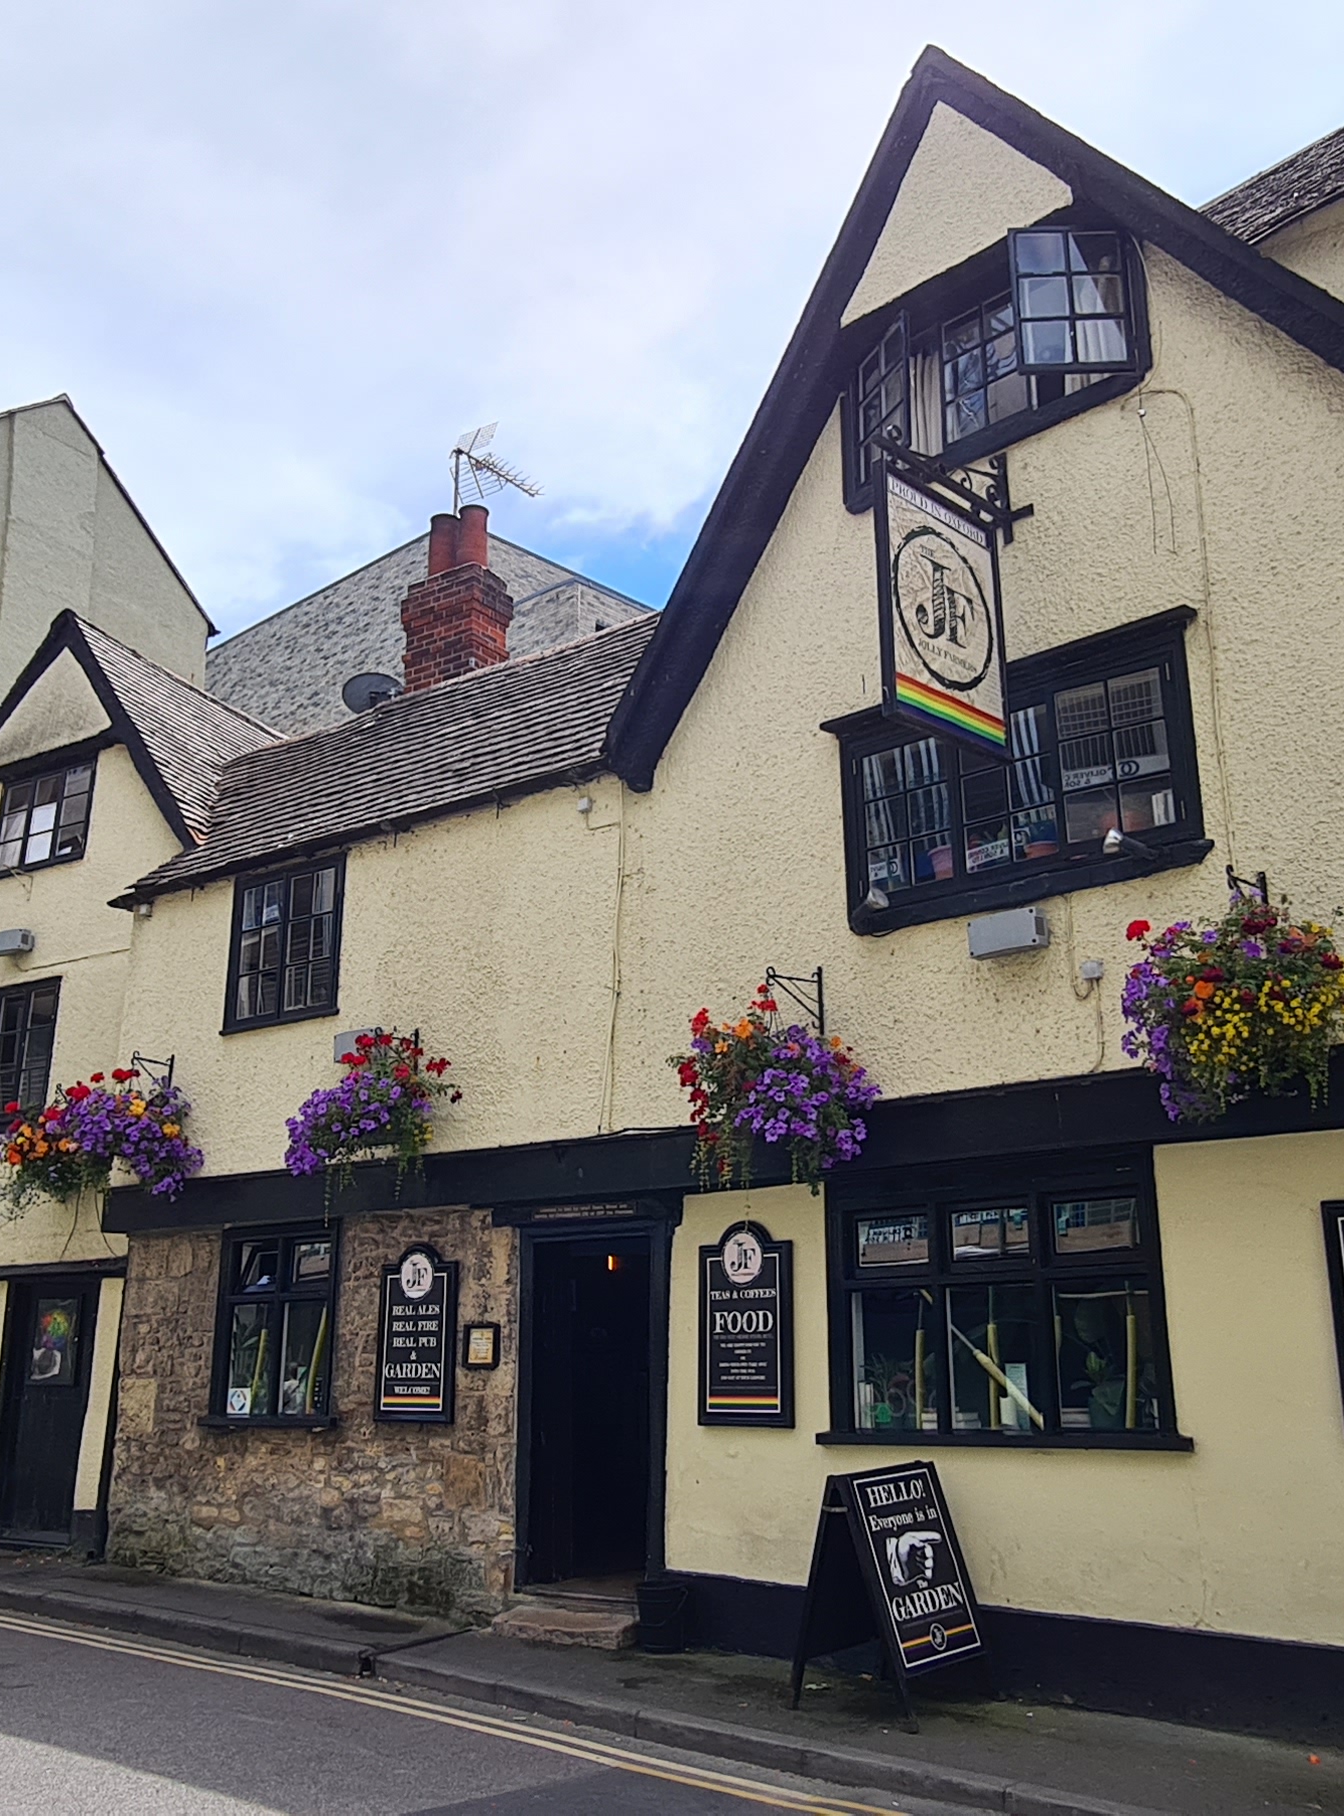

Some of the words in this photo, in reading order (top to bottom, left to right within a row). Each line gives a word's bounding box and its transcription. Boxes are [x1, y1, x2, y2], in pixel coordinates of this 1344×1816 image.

[891, 478, 928, 510] PROUD
[931, 502, 941, 518] IN
[944, 512, 983, 544] OXFORD
[919, 544, 936, 558] THE
[918, 638, 943, 657] JOLLY
[710, 1290, 731, 1300] TEAS
[739, 1288, 777, 1299] COFFEES
[392, 1305, 416, 1316] REAL
[416, 1304, 441, 1315] ALES
[392, 1321, 416, 1332] REAL
[417, 1320, 439, 1332] FIRE
[712, 1310, 774, 1334] FOOD
[392, 1336, 417, 1348] REAL
[418, 1336, 437, 1348] PUB
[409, 1349, 417, 1360] &
[385, 1362, 441, 1379] GARDEN
[865, 1478, 926, 1508] HELLO!
[868, 1512, 914, 1532] Everyone
[914, 1506, 925, 1522] is
[924, 1504, 938, 1520] in
[892, 1581, 964, 1622] GARDEN
